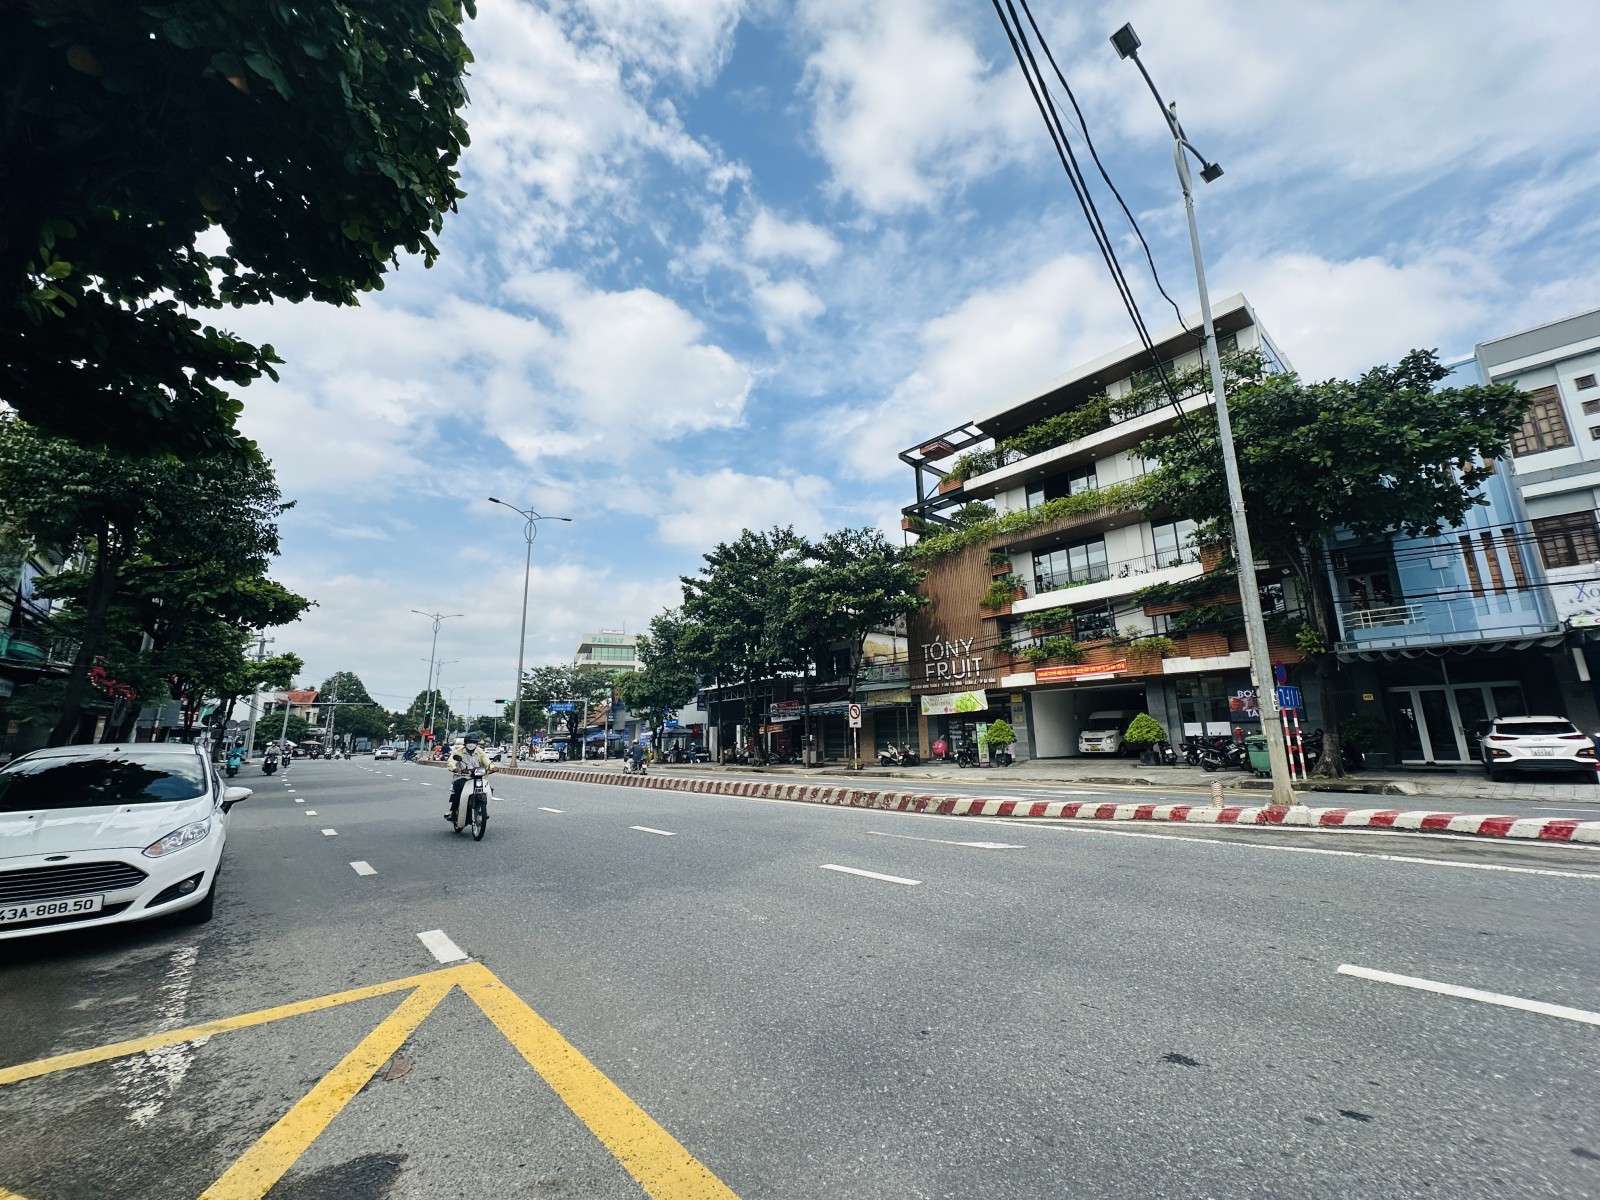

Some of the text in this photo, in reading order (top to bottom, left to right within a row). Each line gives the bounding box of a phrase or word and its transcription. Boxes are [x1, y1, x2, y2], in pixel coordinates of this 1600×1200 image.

[591, 636, 625, 644] FAMILY
[921, 634, 975, 662] TÓNY
[925, 656, 983, 682] FRUIT
